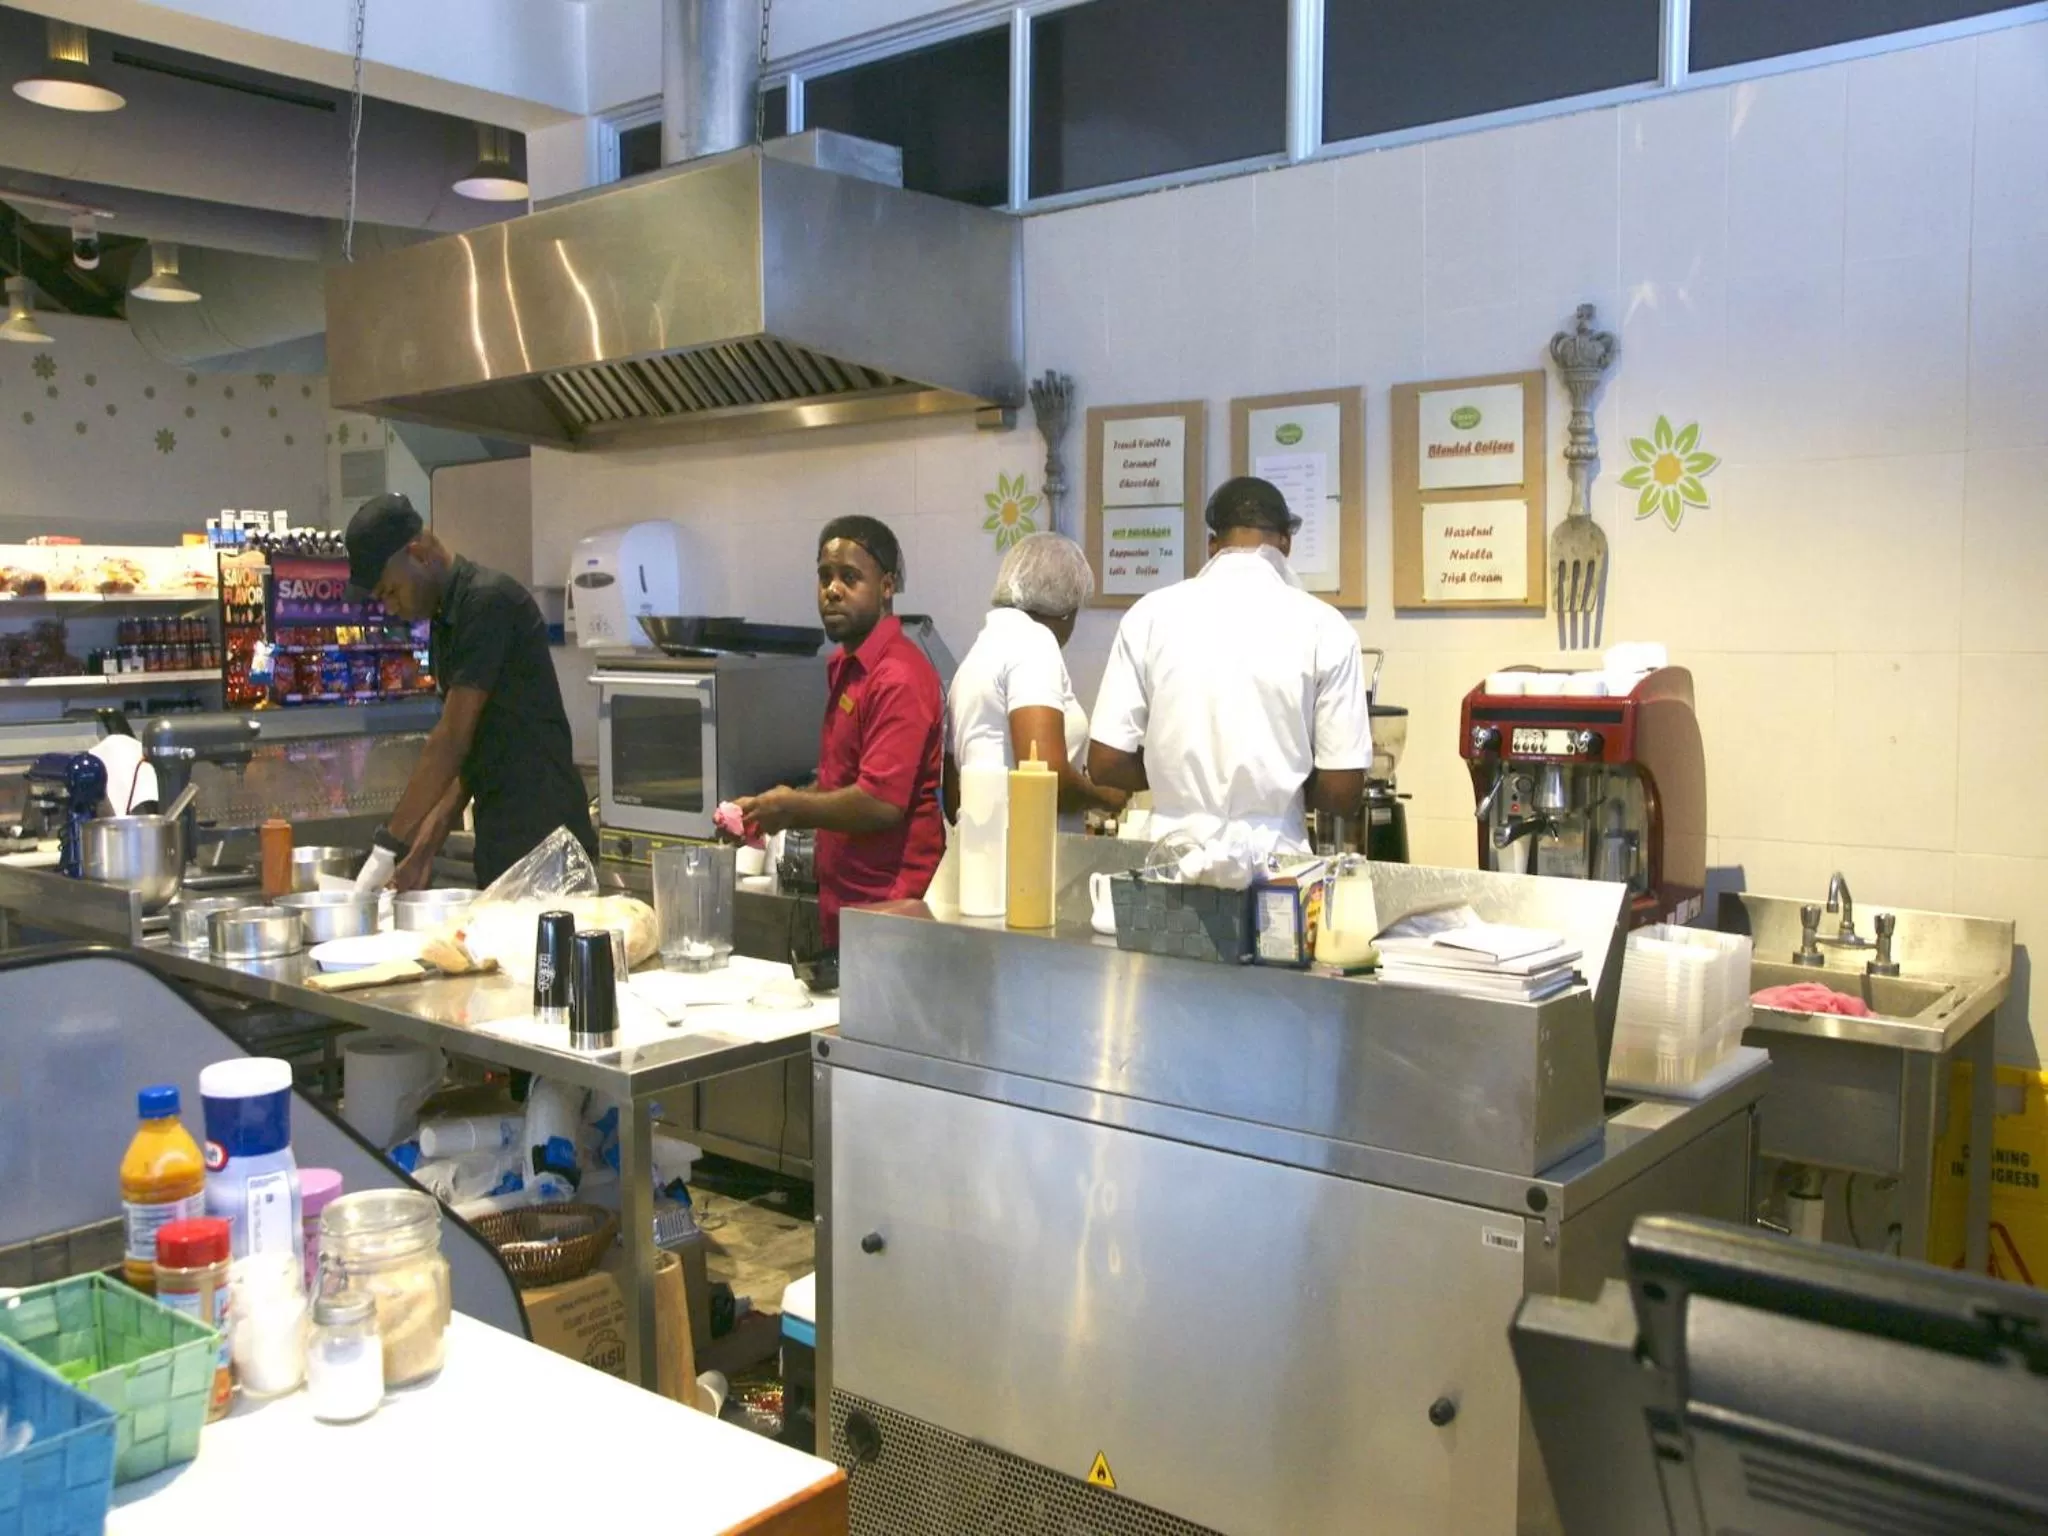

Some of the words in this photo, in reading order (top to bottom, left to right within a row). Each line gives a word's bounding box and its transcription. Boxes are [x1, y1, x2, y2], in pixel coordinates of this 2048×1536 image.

[1113, 438, 1137, 451] French
[1138, 437, 1172, 449] Vanilla
[1427, 441, 1472, 458] Blended
[1474, 440, 1515, 456] Coffees
[1122, 458, 1158, 469] Caramel
[1118, 477, 1161, 489] Chocolate
[1444, 525, 1494, 538] Hazelnut
[1159, 547, 1174, 557] Tea
[1449, 548, 1494, 560] Nutella
[1136, 565, 1160, 577] Coffee
[1440, 572, 1466, 585] Irish
[1469, 571, 1503, 584] Cream
[1960, 1144, 2030, 1168] CNING
